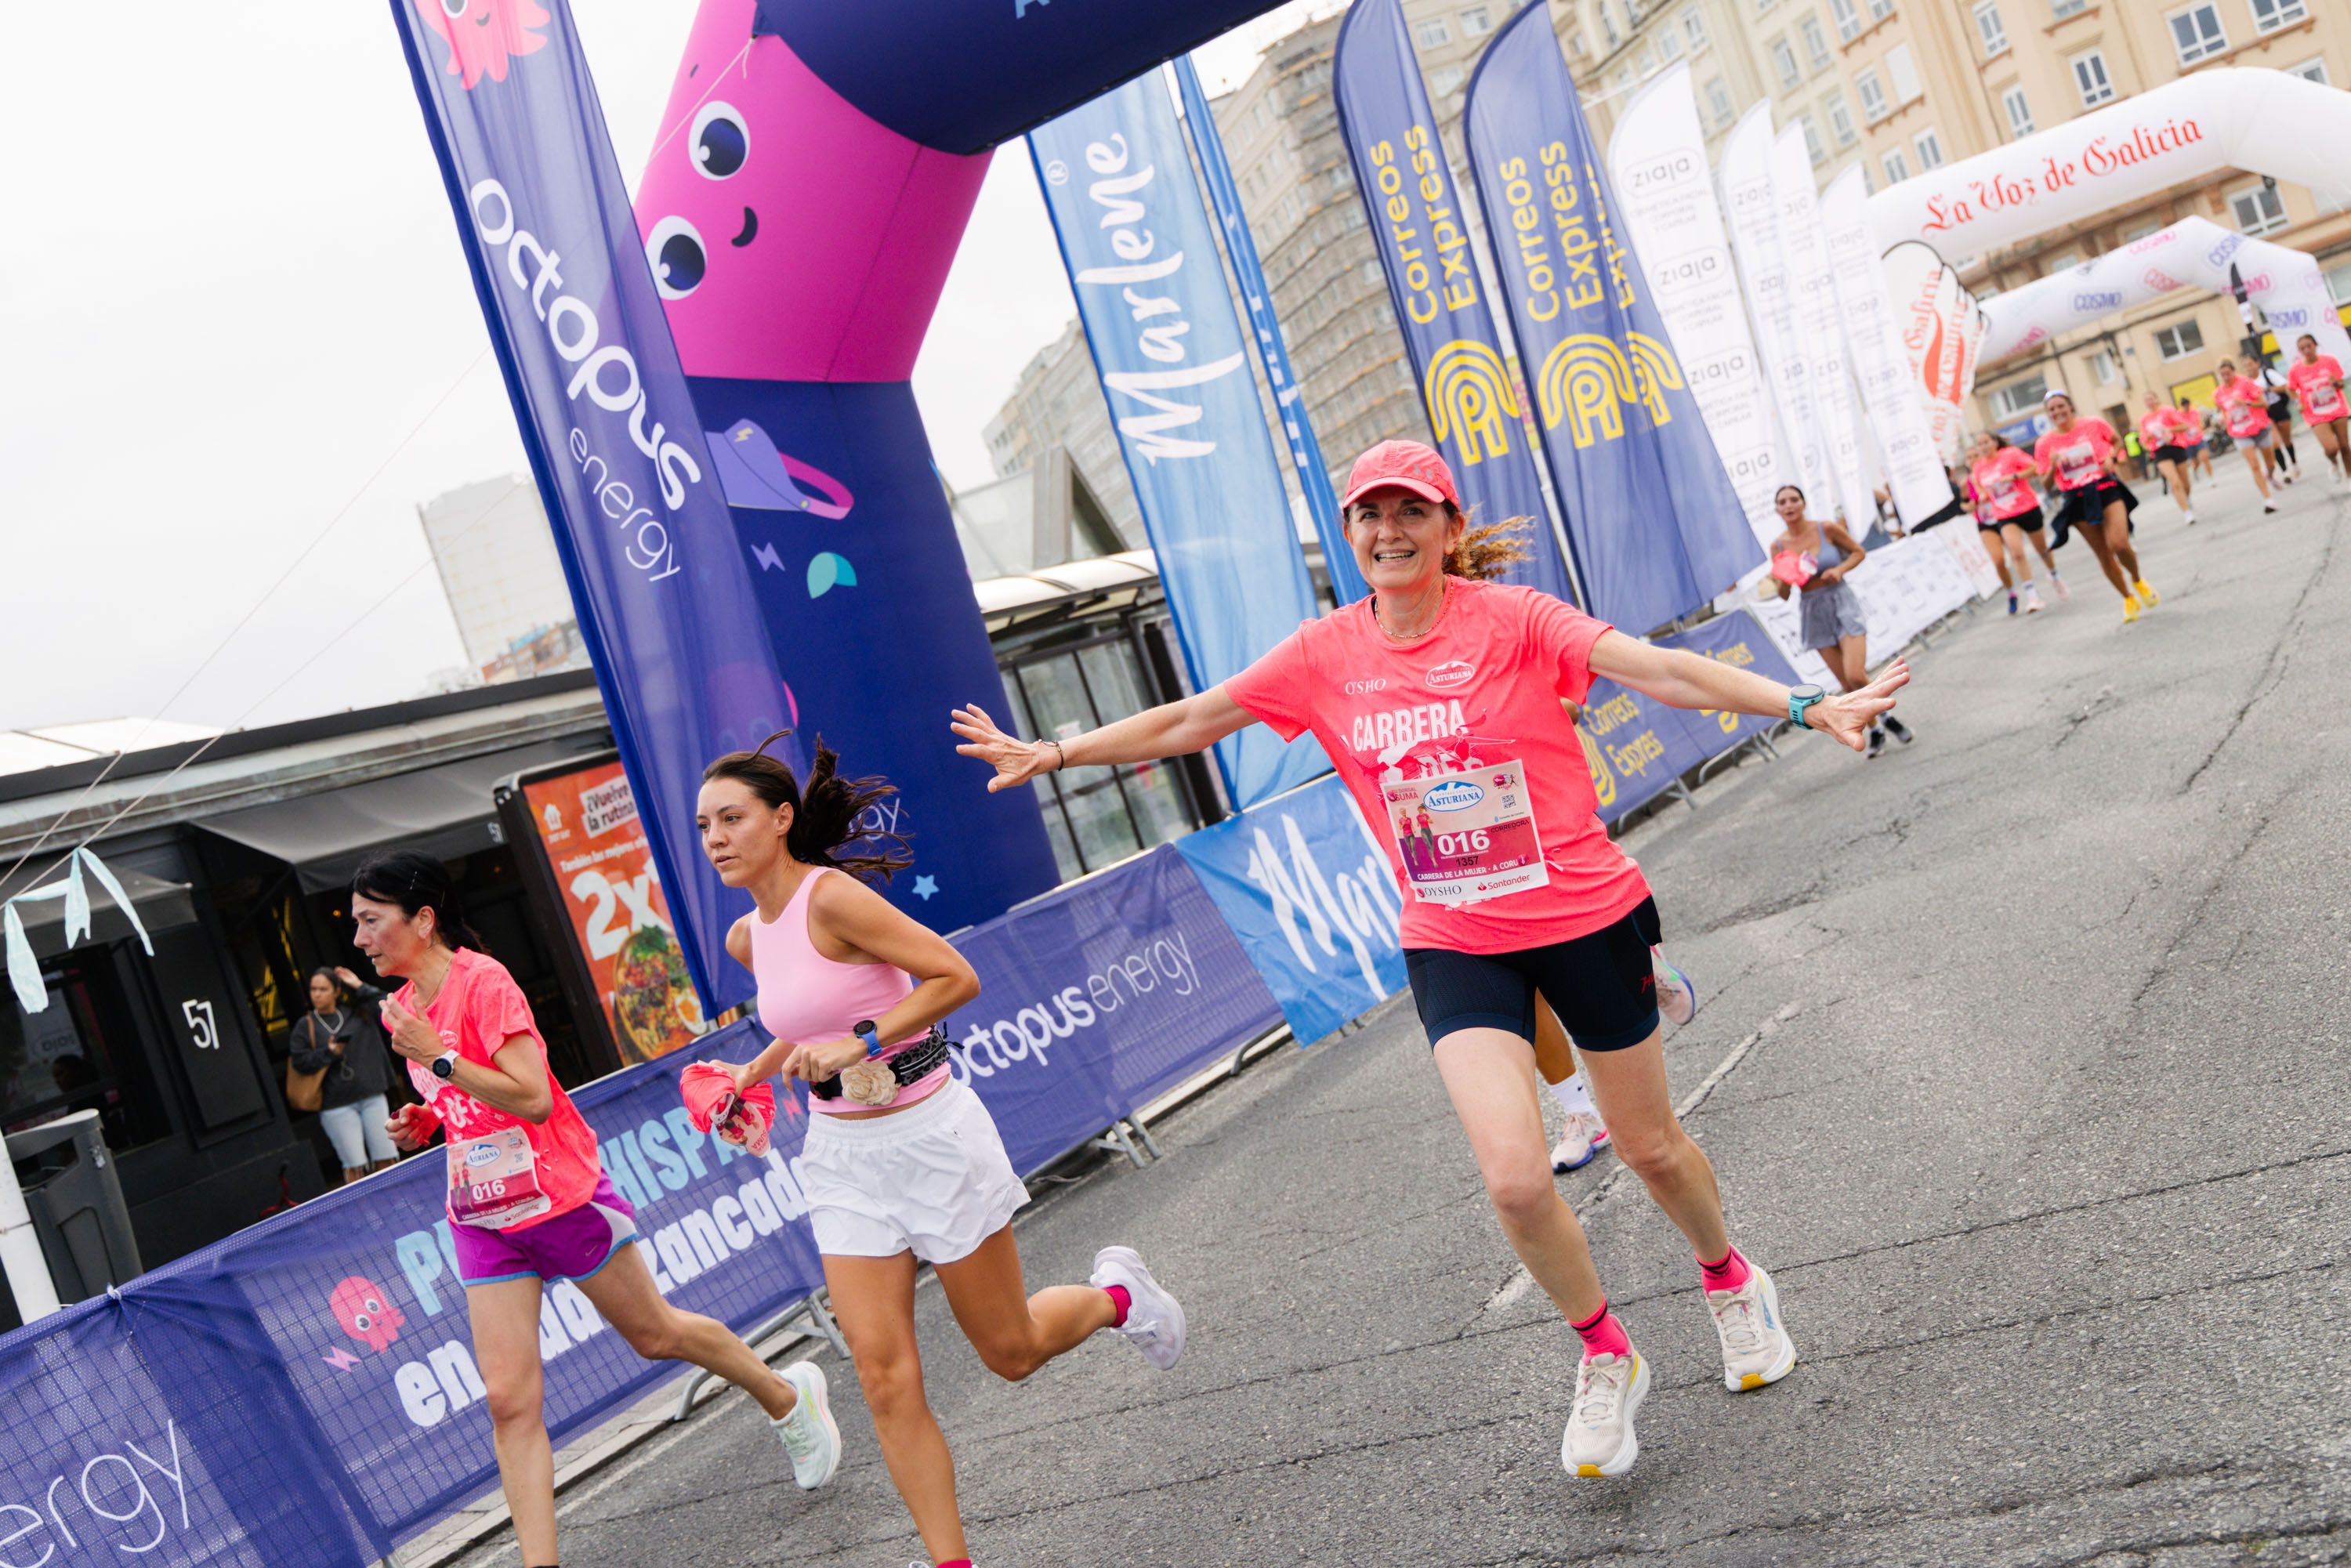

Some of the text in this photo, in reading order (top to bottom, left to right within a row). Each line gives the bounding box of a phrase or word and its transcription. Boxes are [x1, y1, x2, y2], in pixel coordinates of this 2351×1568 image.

[1633, 158, 1690, 188] ziaja
[1921, 118, 2203, 238] La Voz de Galicia
[1371, 140, 1437, 324] Correos
[1404, 125, 1478, 312] Express
[1540, 141, 1605, 310] Express
[1500, 157, 1560, 322] Correos
[1661, 256, 1716, 285] ziaja
[1074, 132, 1244, 466] Marlene
[470, 179, 701, 509] octopus
[1690, 355, 1744, 385] ziaja
[1730, 452, 1770, 478] iaja
[570, 427, 680, 581] energy
[1345, 678, 1386, 695] OSHO
[1429, 670, 1472, 684] ASTURIANA
[1353, 699, 1469, 751] CARRERA
[1583, 692, 1640, 736] Correos
[1396, 792, 1418, 801] SUMA
[1429, 792, 1480, 807] ASTURIANA
[587, 801, 635, 831] la rutina
[1491, 820, 1530, 834] CORREDORA
[1437, 830, 1491, 856] 016
[1417, 871, 1444, 882] CARRERA
[1465, 867, 1487, 876] MUJER
[1499, 859, 1519, 871] CORU
[1455, 856, 1479, 867] 1357
[1425, 885, 1462, 897] OYSHO
[1488, 874, 1531, 890] Santander
[1087, 931, 1201, 1012] energy
[182, 998, 219, 1050] 57
[473, 1179, 506, 1201] 016
[394, 1339, 488, 1427] en
